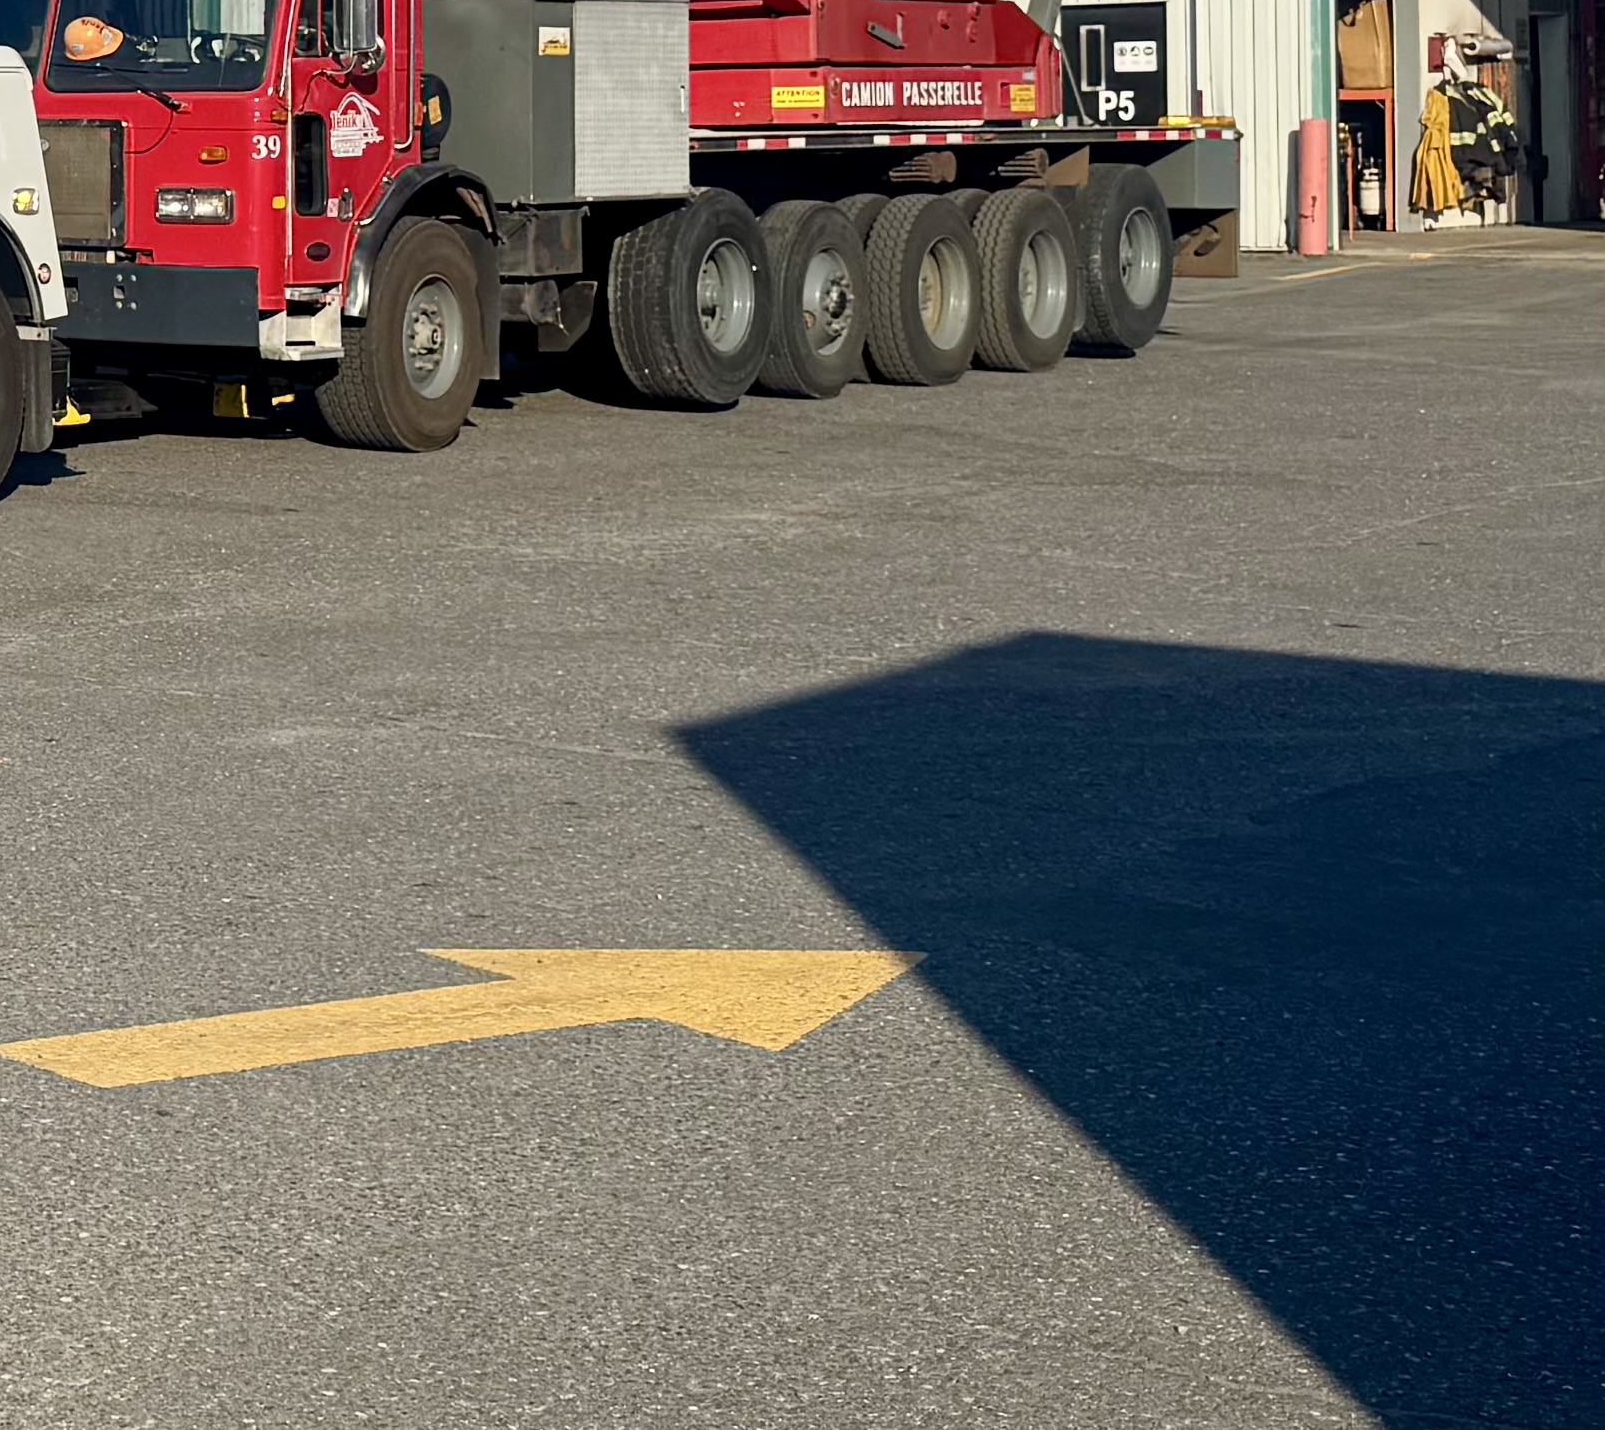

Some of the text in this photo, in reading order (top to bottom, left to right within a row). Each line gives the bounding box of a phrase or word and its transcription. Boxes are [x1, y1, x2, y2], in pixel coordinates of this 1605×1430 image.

[842, 81, 894, 107] CAMION
[903, 81, 983, 106] PASSERELLE
[1098, 90, 1136, 122] P5
[252, 134, 282, 160] 39
